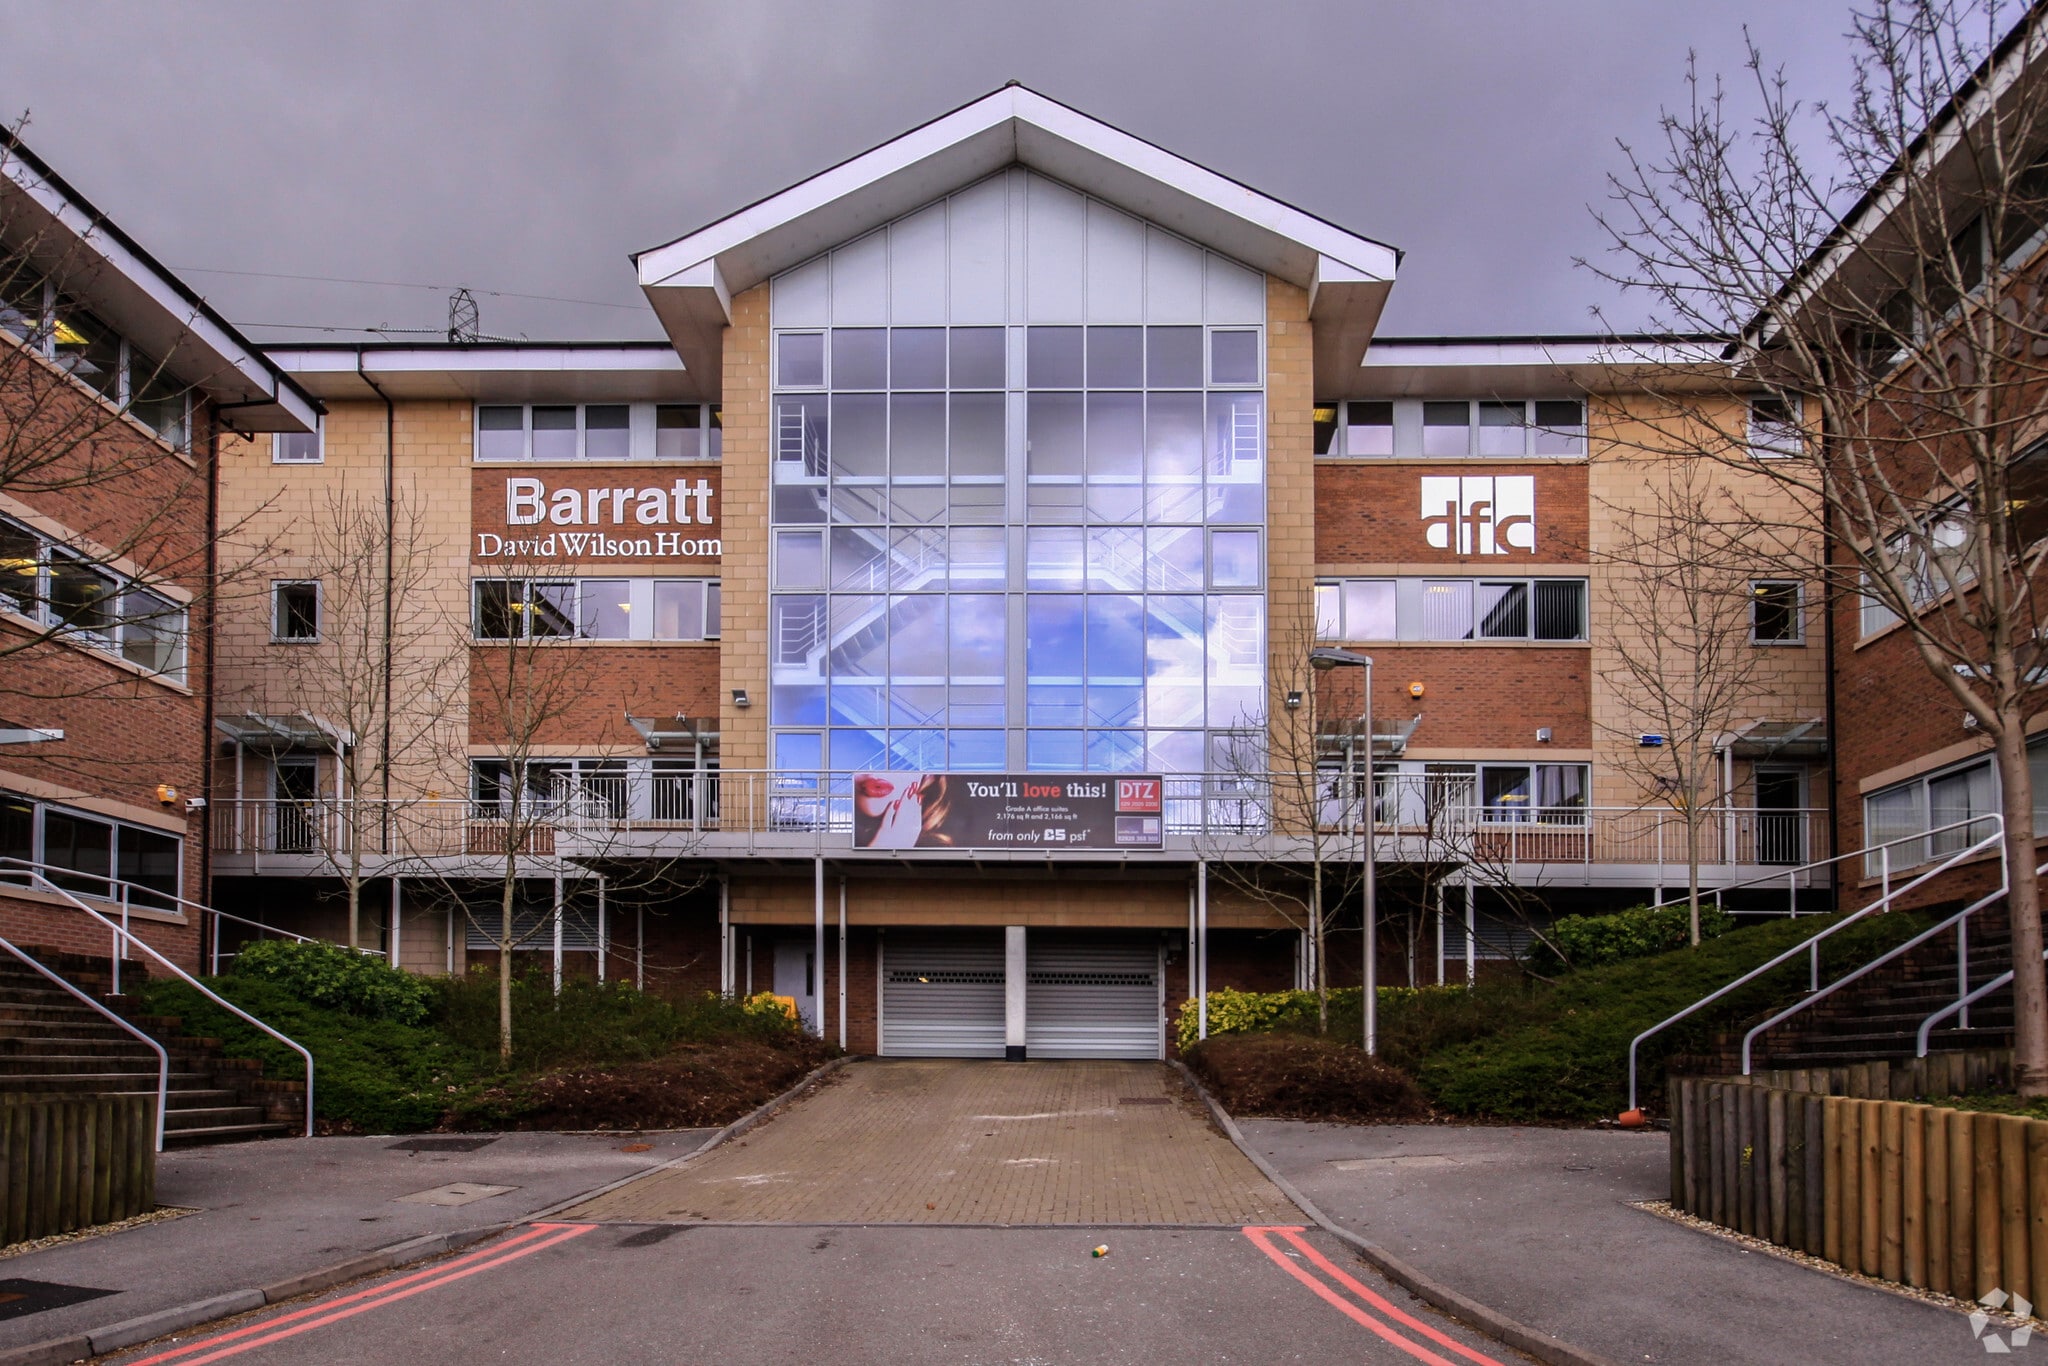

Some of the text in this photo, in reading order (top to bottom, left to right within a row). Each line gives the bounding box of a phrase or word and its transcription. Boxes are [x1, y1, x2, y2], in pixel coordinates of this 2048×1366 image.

[506, 477, 714, 526] Barratt
[478, 533, 557, 556] David
[558, 533, 653, 556] Wilson
[967, 781, 1106, 798] You'll love this!
[1120, 782, 1154, 799] DTZ
[988, 829, 1013, 841] from
[1016, 829, 1040, 844] only
[1043, 828, 1066, 841] £5
